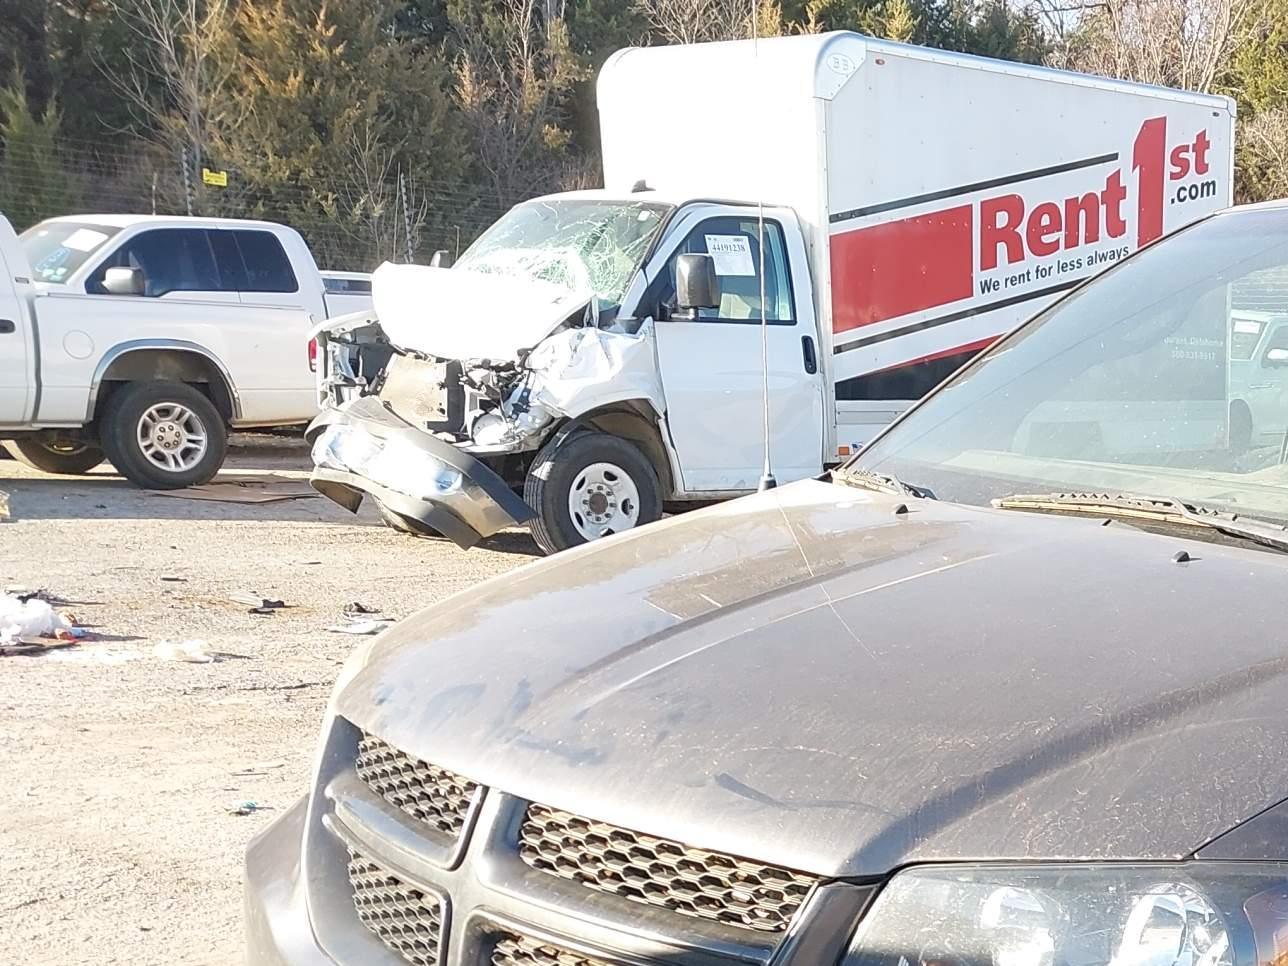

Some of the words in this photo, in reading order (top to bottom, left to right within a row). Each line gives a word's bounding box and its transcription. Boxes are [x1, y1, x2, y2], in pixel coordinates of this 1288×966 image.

[1170, 180, 1216, 204] .com
[980, 170, 1126, 271] Rent
[979, 277, 1001, 295] We
[1004, 269, 1031, 289] rent
[1035, 264, 1053, 280] for
[1057, 258, 1082, 274] less
[1087, 246, 1129, 266] always
